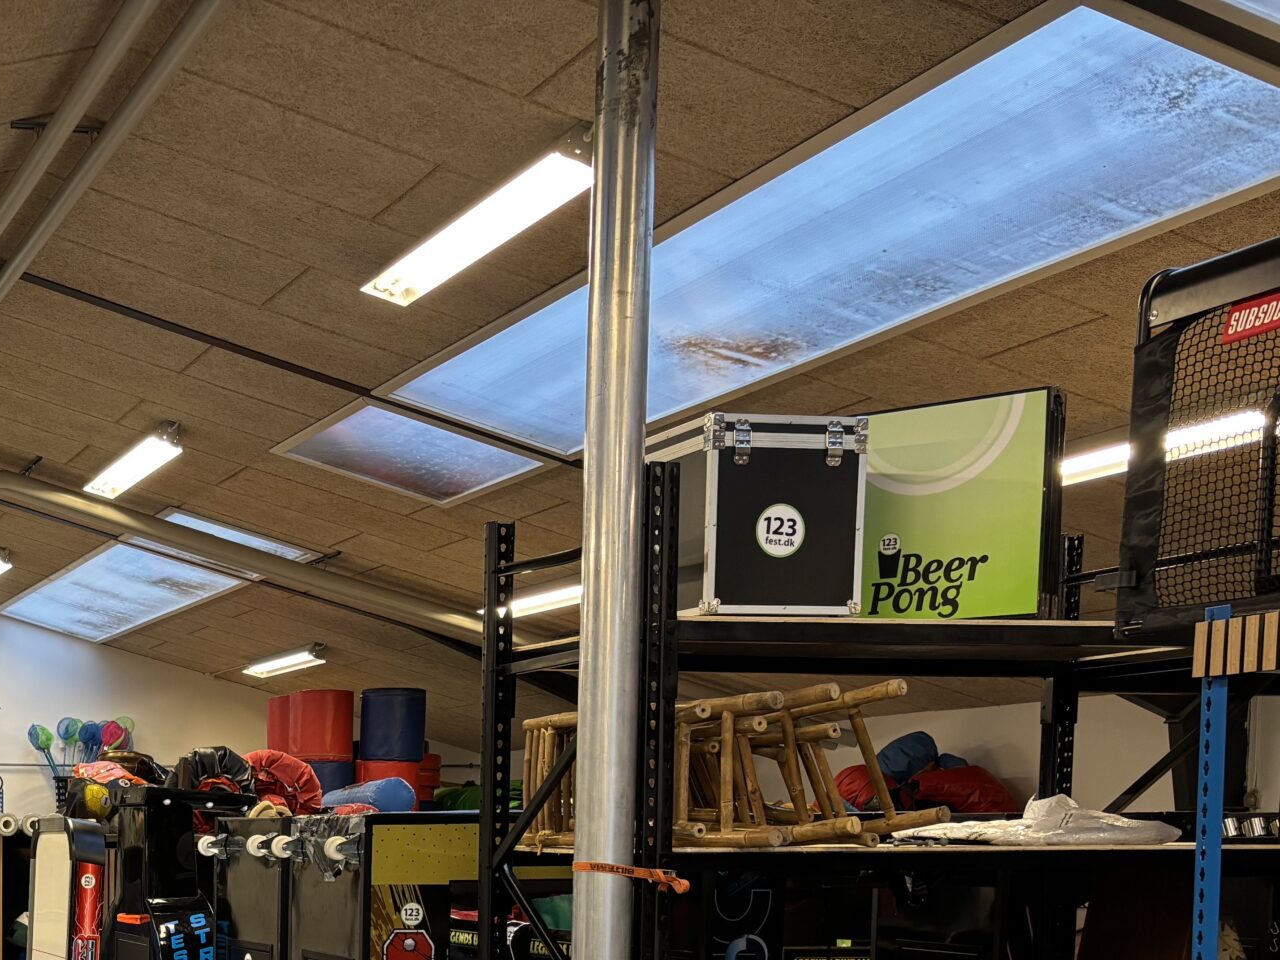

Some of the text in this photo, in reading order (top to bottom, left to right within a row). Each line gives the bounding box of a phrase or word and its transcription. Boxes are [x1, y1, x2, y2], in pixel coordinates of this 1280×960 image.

[1228, 301, 1280, 335] SUBSOC
[763, 516, 797, 537] 123
[765, 536, 796, 548] fest.dk
[882, 537, 898, 547] 123
[897, 553, 989, 588] Beer
[868, 581, 963, 619] Pong
[403, 908, 420, 917] 123
[450, 932, 472, 945] GENDS
